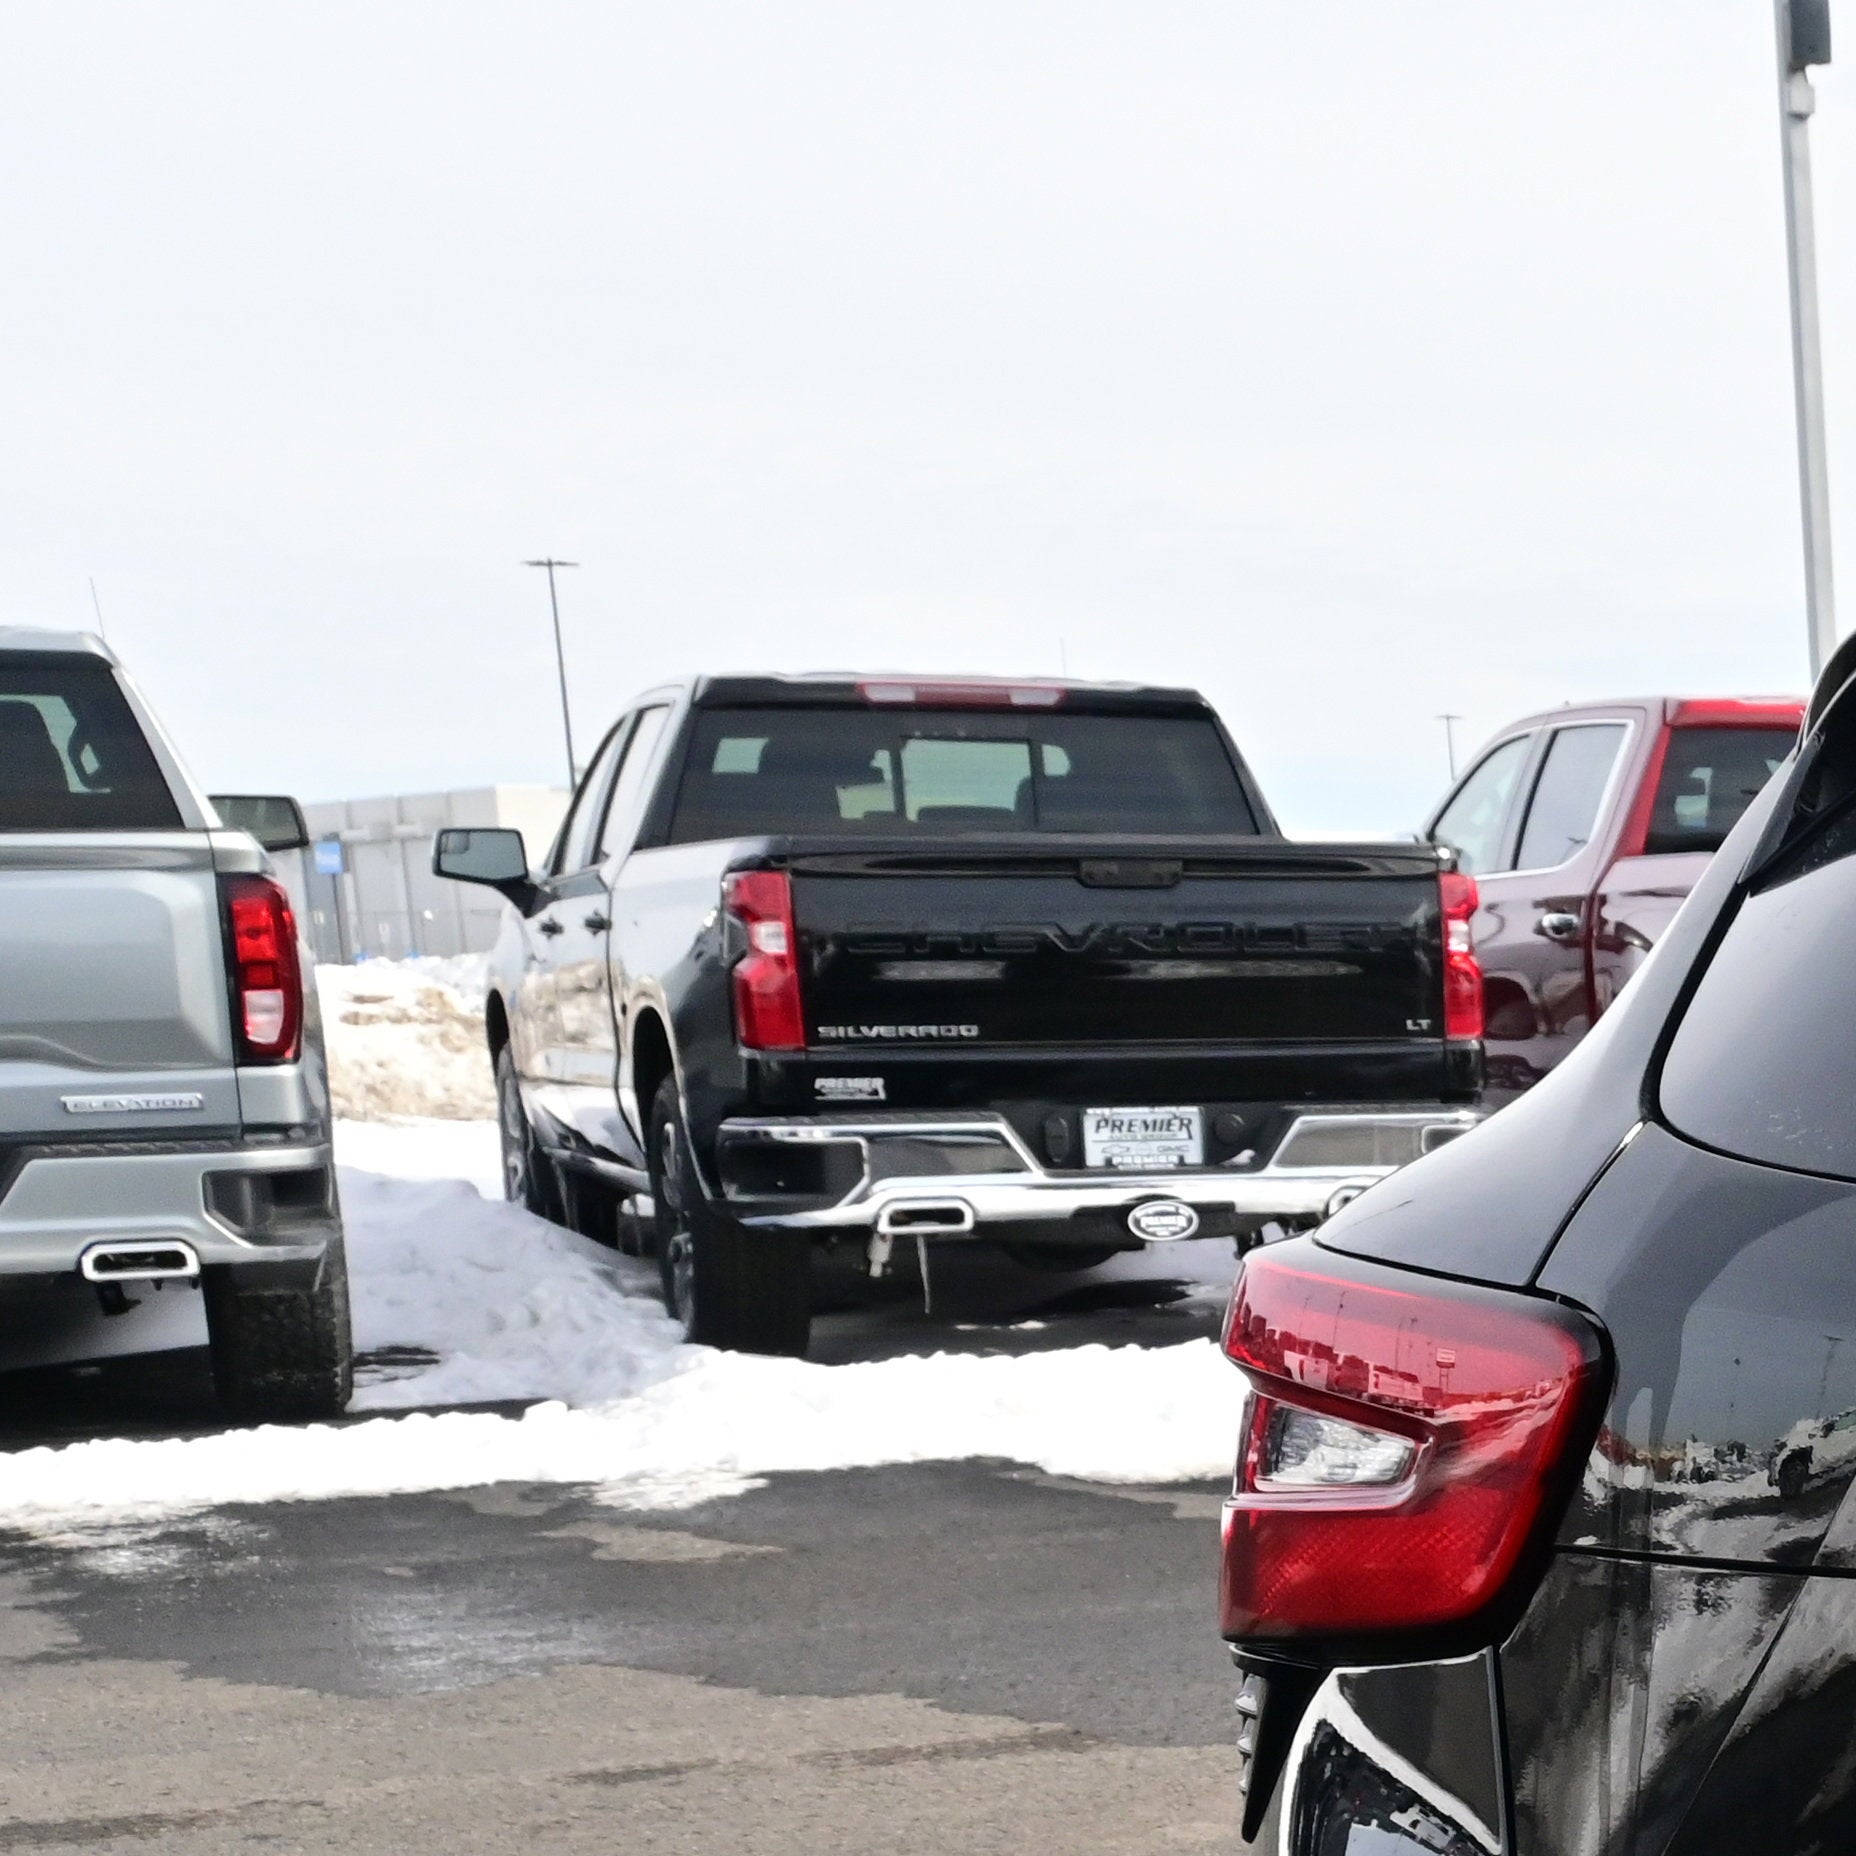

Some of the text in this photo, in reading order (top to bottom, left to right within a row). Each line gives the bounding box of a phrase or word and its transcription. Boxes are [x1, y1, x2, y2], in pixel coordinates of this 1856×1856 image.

[1405, 1018, 1432, 1031] LT
[818, 1025, 979, 1038] SILVERADO
[1095, 1118, 1193, 1140] PREMIER
